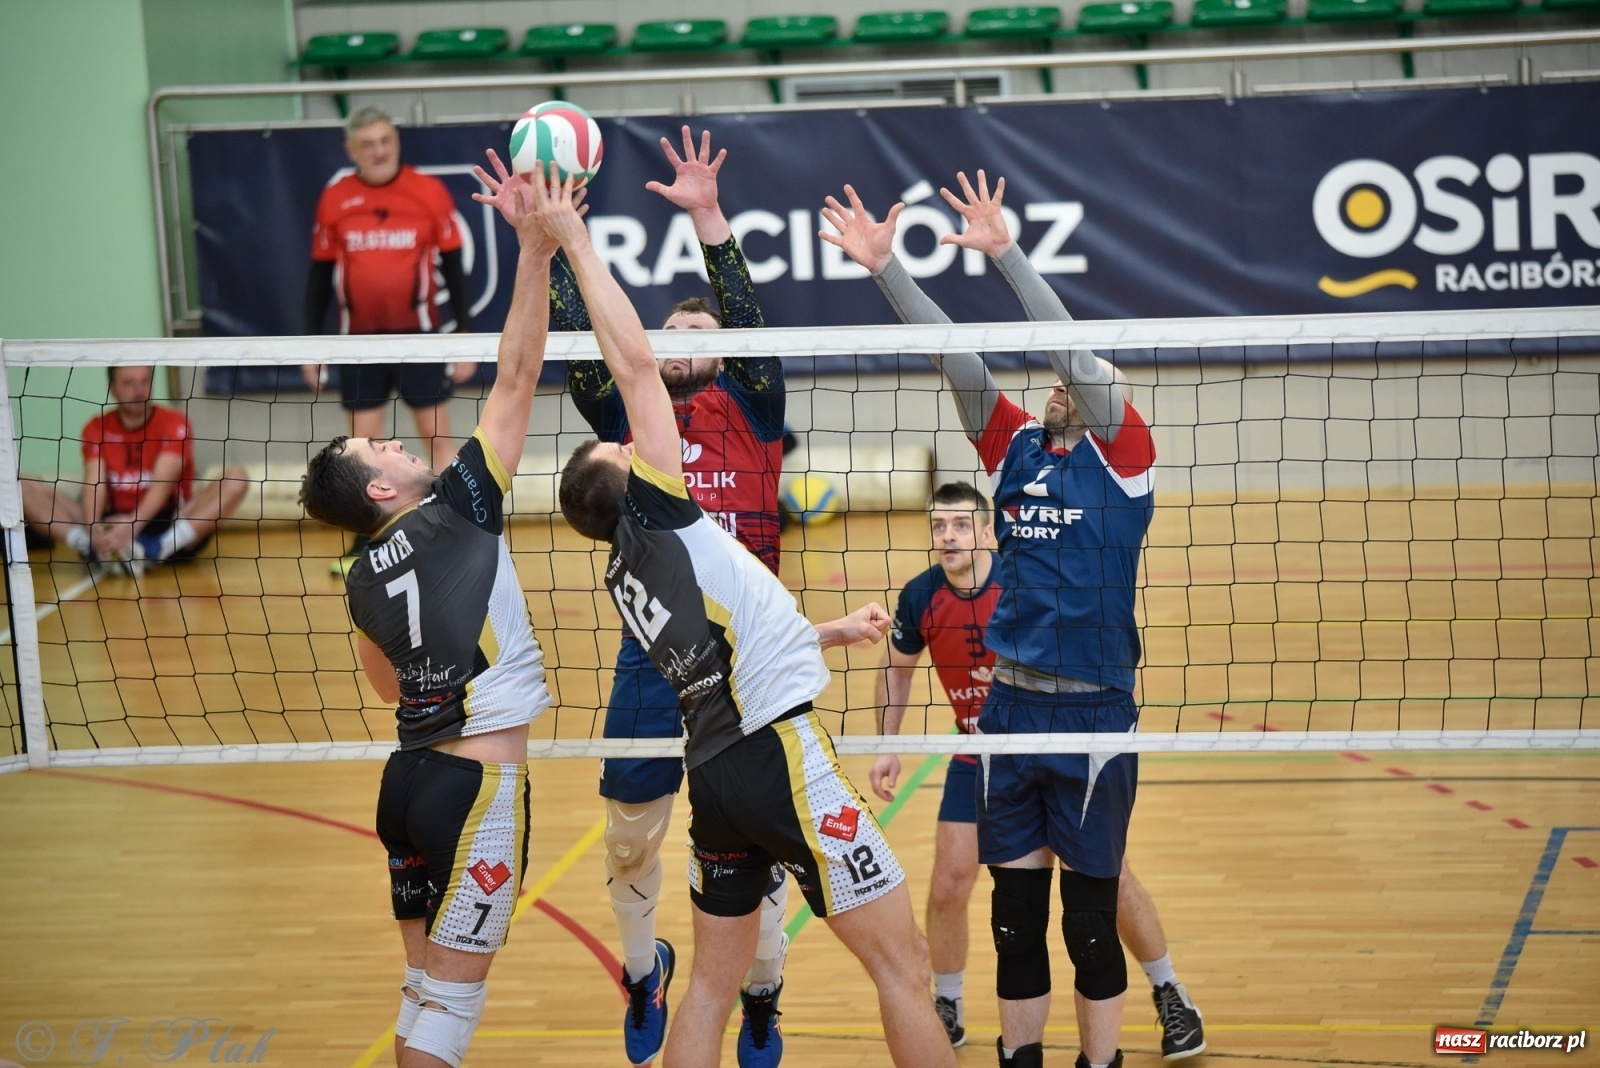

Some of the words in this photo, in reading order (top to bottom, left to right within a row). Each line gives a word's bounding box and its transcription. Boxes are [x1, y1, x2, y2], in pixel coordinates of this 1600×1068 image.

[587, 180, 1089, 288] RACIBÓRZ
[385, 568, 423, 650] 7
[613, 570, 673, 653] 12
[825, 818, 853, 833] Enter
[476, 863, 497, 887] Enter
[841, 844, 883, 885] 12
[471, 901, 493, 936] 7
